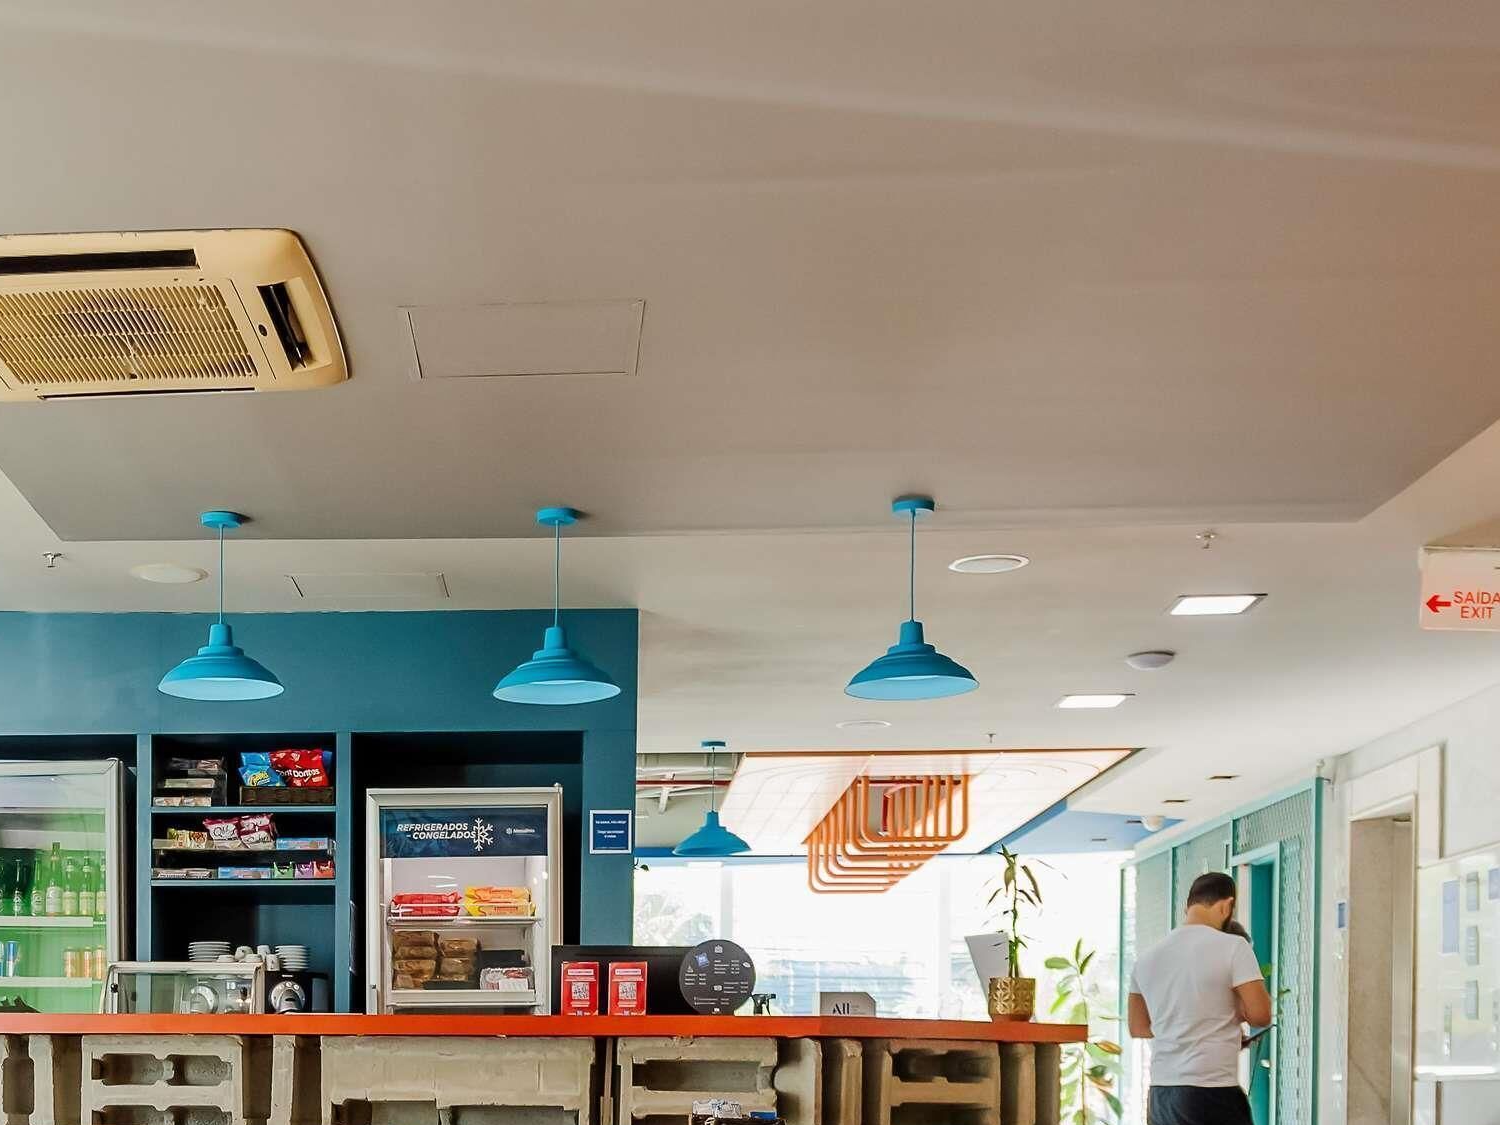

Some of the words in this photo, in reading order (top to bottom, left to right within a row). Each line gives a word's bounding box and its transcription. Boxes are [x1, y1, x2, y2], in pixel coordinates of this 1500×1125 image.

[1460, 605, 1494, 619] EXIT
[396, 823, 468, 832] REFRIGERADOS
[412, 831, 476, 840] CONGELADOS
